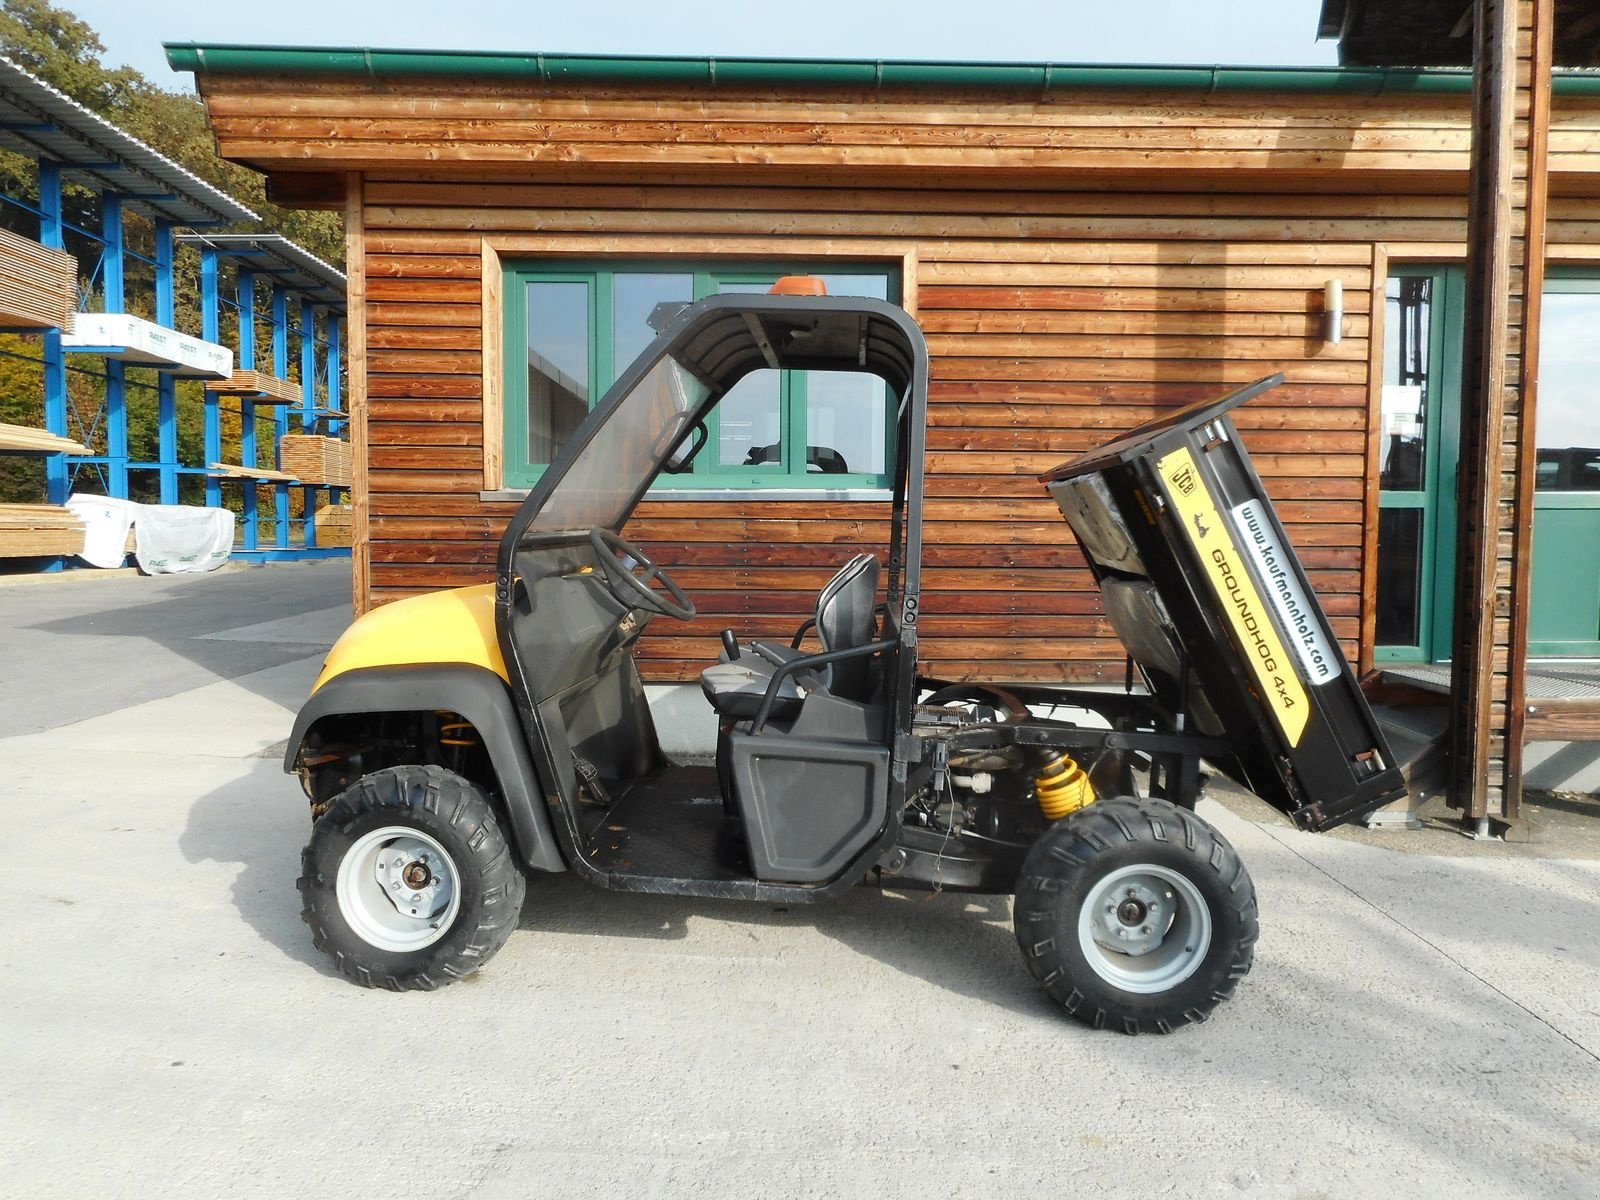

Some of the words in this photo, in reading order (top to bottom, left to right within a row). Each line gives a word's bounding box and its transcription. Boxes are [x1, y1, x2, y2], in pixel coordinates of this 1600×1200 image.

[1172, 468, 1194, 494] JCB
[1211, 548, 1278, 673] GROUNDHOG
[1273, 676, 1295, 708] 4x4
[1241, 507, 1329, 678] www.kaufmannholz.com
